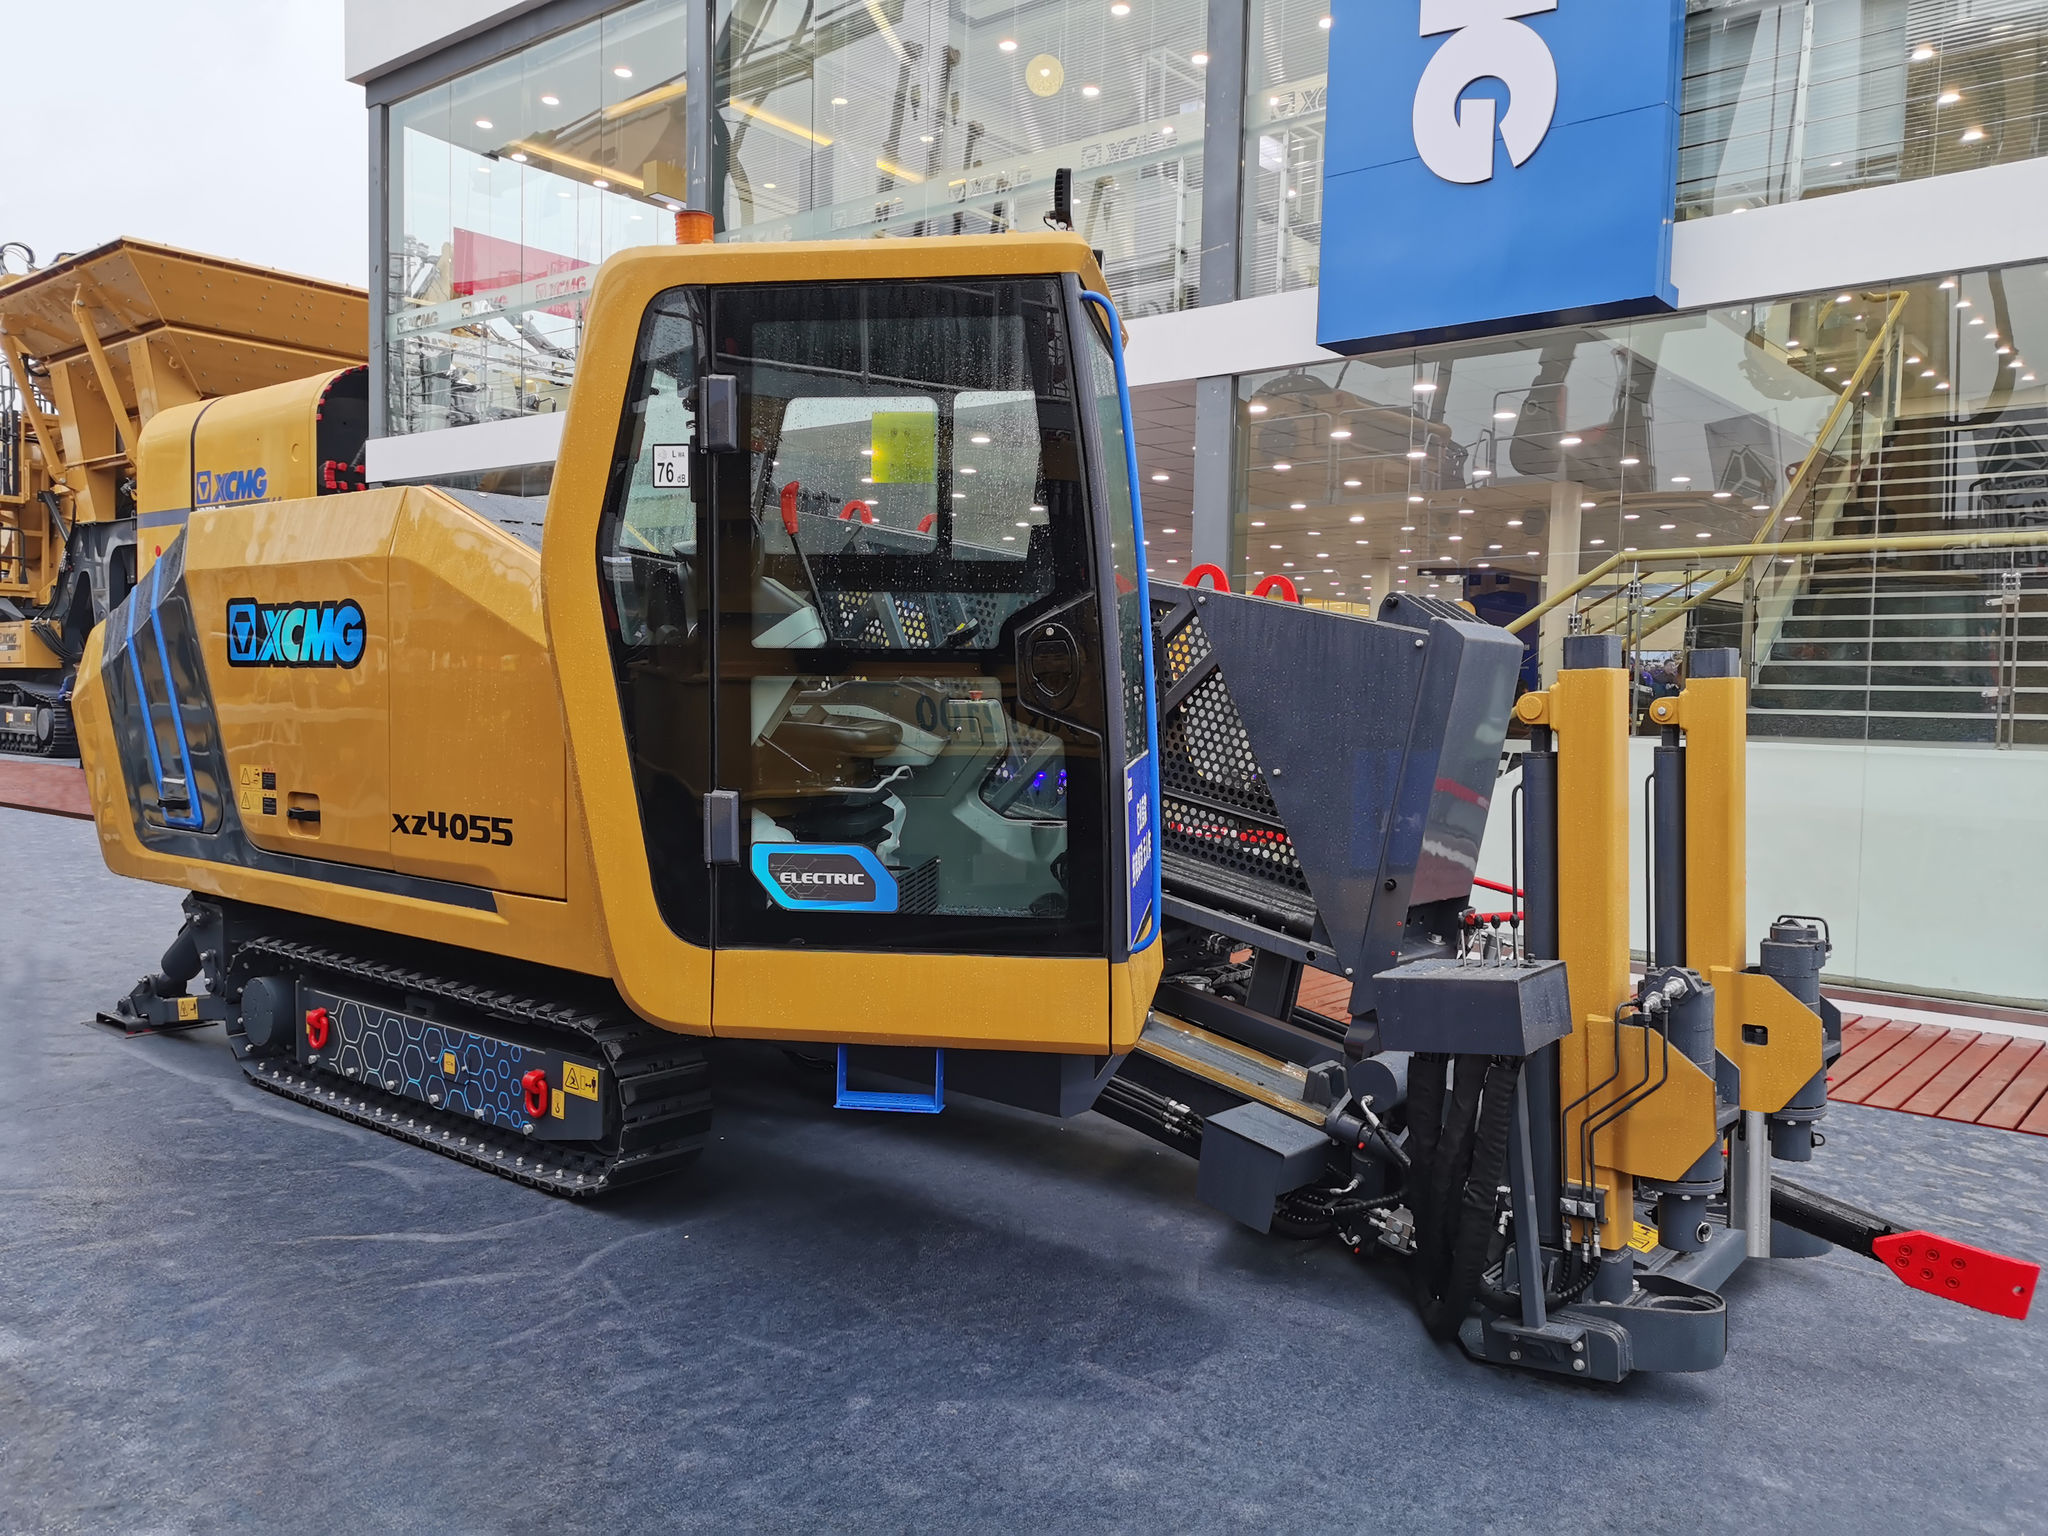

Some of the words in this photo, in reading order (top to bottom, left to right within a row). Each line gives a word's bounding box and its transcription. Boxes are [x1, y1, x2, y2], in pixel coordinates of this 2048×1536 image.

[212, 467, 267, 503] XCMG
[657, 462, 674, 483] 76
[256, 605, 364, 663] XCMG
[780, 872, 865, 885] ELECTRIC
